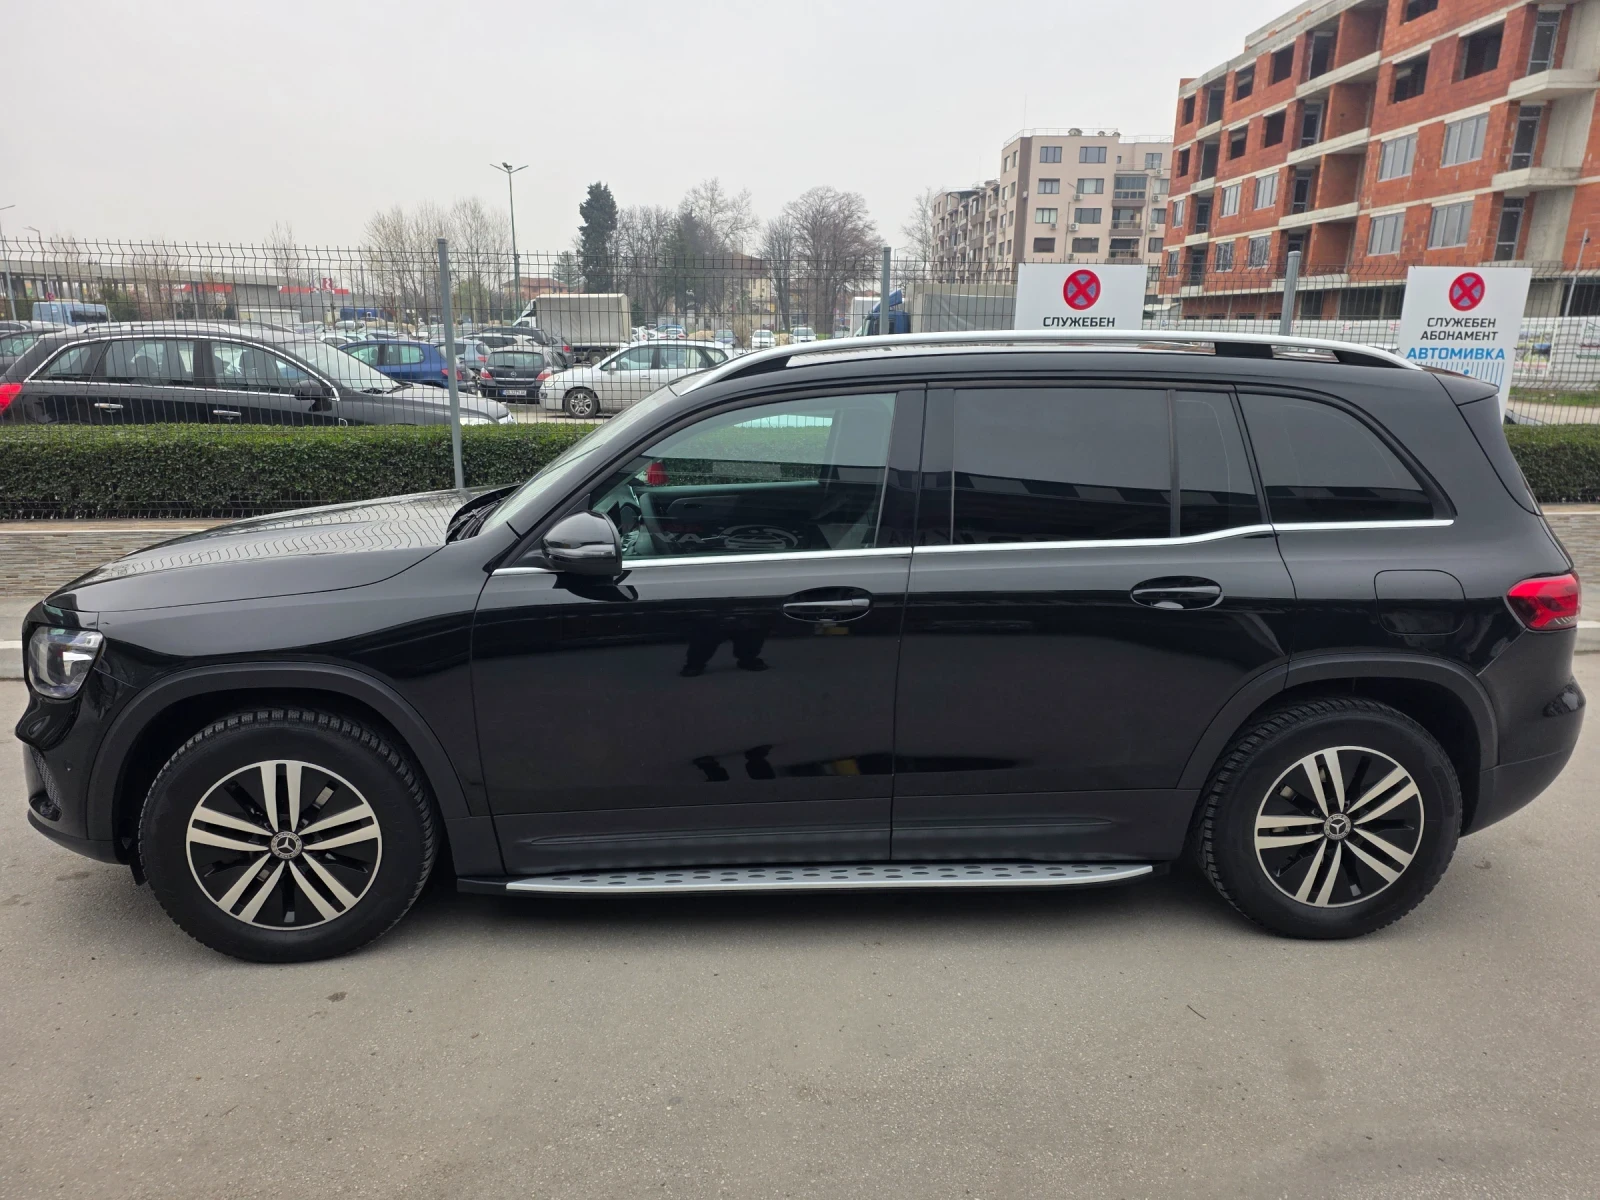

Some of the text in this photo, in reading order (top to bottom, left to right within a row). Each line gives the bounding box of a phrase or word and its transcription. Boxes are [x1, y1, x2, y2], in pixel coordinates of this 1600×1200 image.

[1042, 316, 1115, 327] СЛУЖЕБЕН
[1427, 317, 1496, 328] СЛУЖЕБЕН
[1420, 331, 1498, 341] АБОНАМЕНТ
[1406, 347, 1505, 360] АВТОМИВКА
